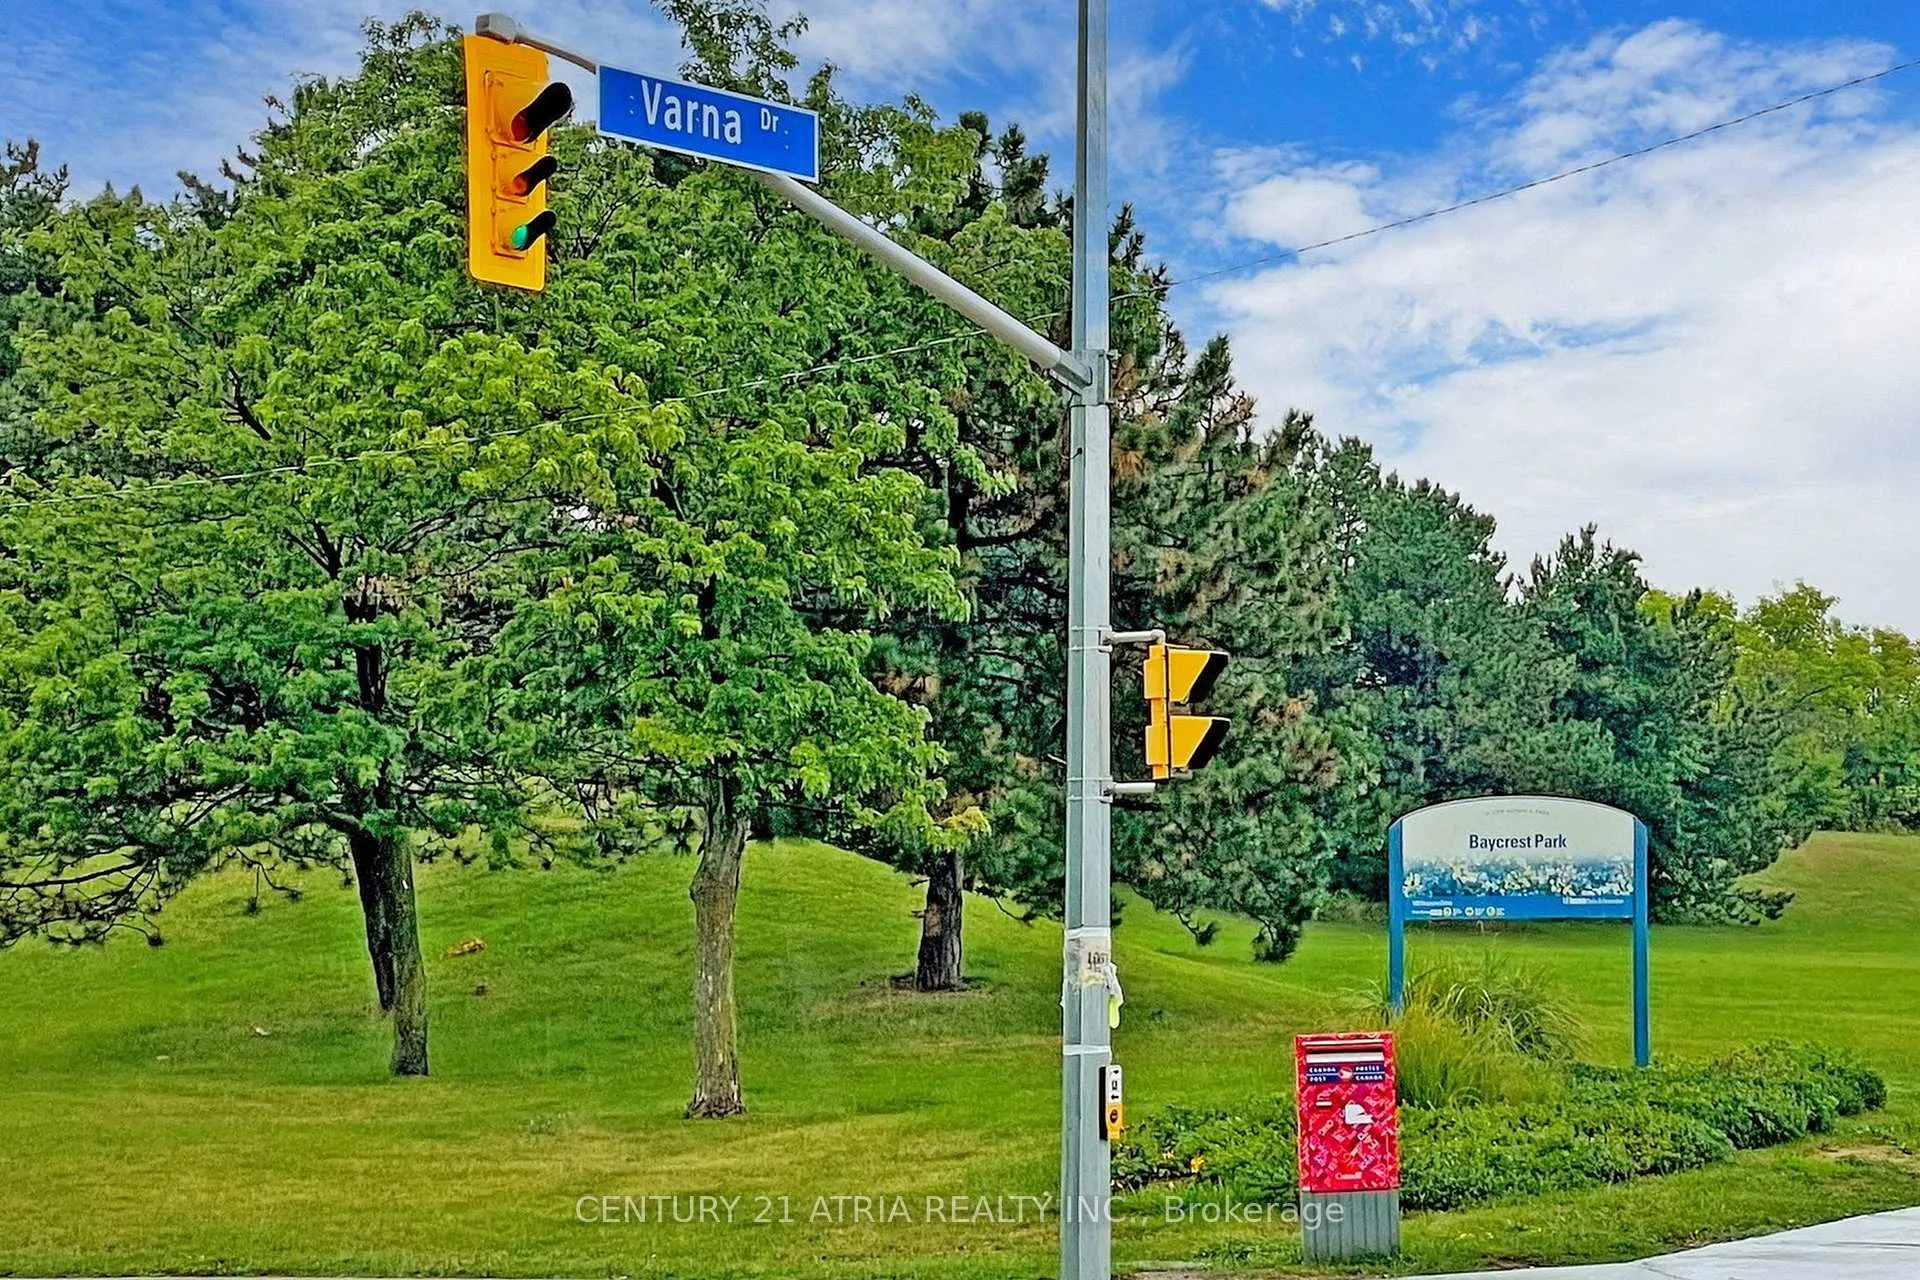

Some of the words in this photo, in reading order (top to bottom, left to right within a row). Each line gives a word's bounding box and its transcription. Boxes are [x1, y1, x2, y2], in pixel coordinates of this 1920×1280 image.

[641, 79, 742, 145] Varna
[760, 108, 779, 133] Dr
[1469, 834, 1531, 852] Baycrest
[1534, 833, 1568, 849] Park
